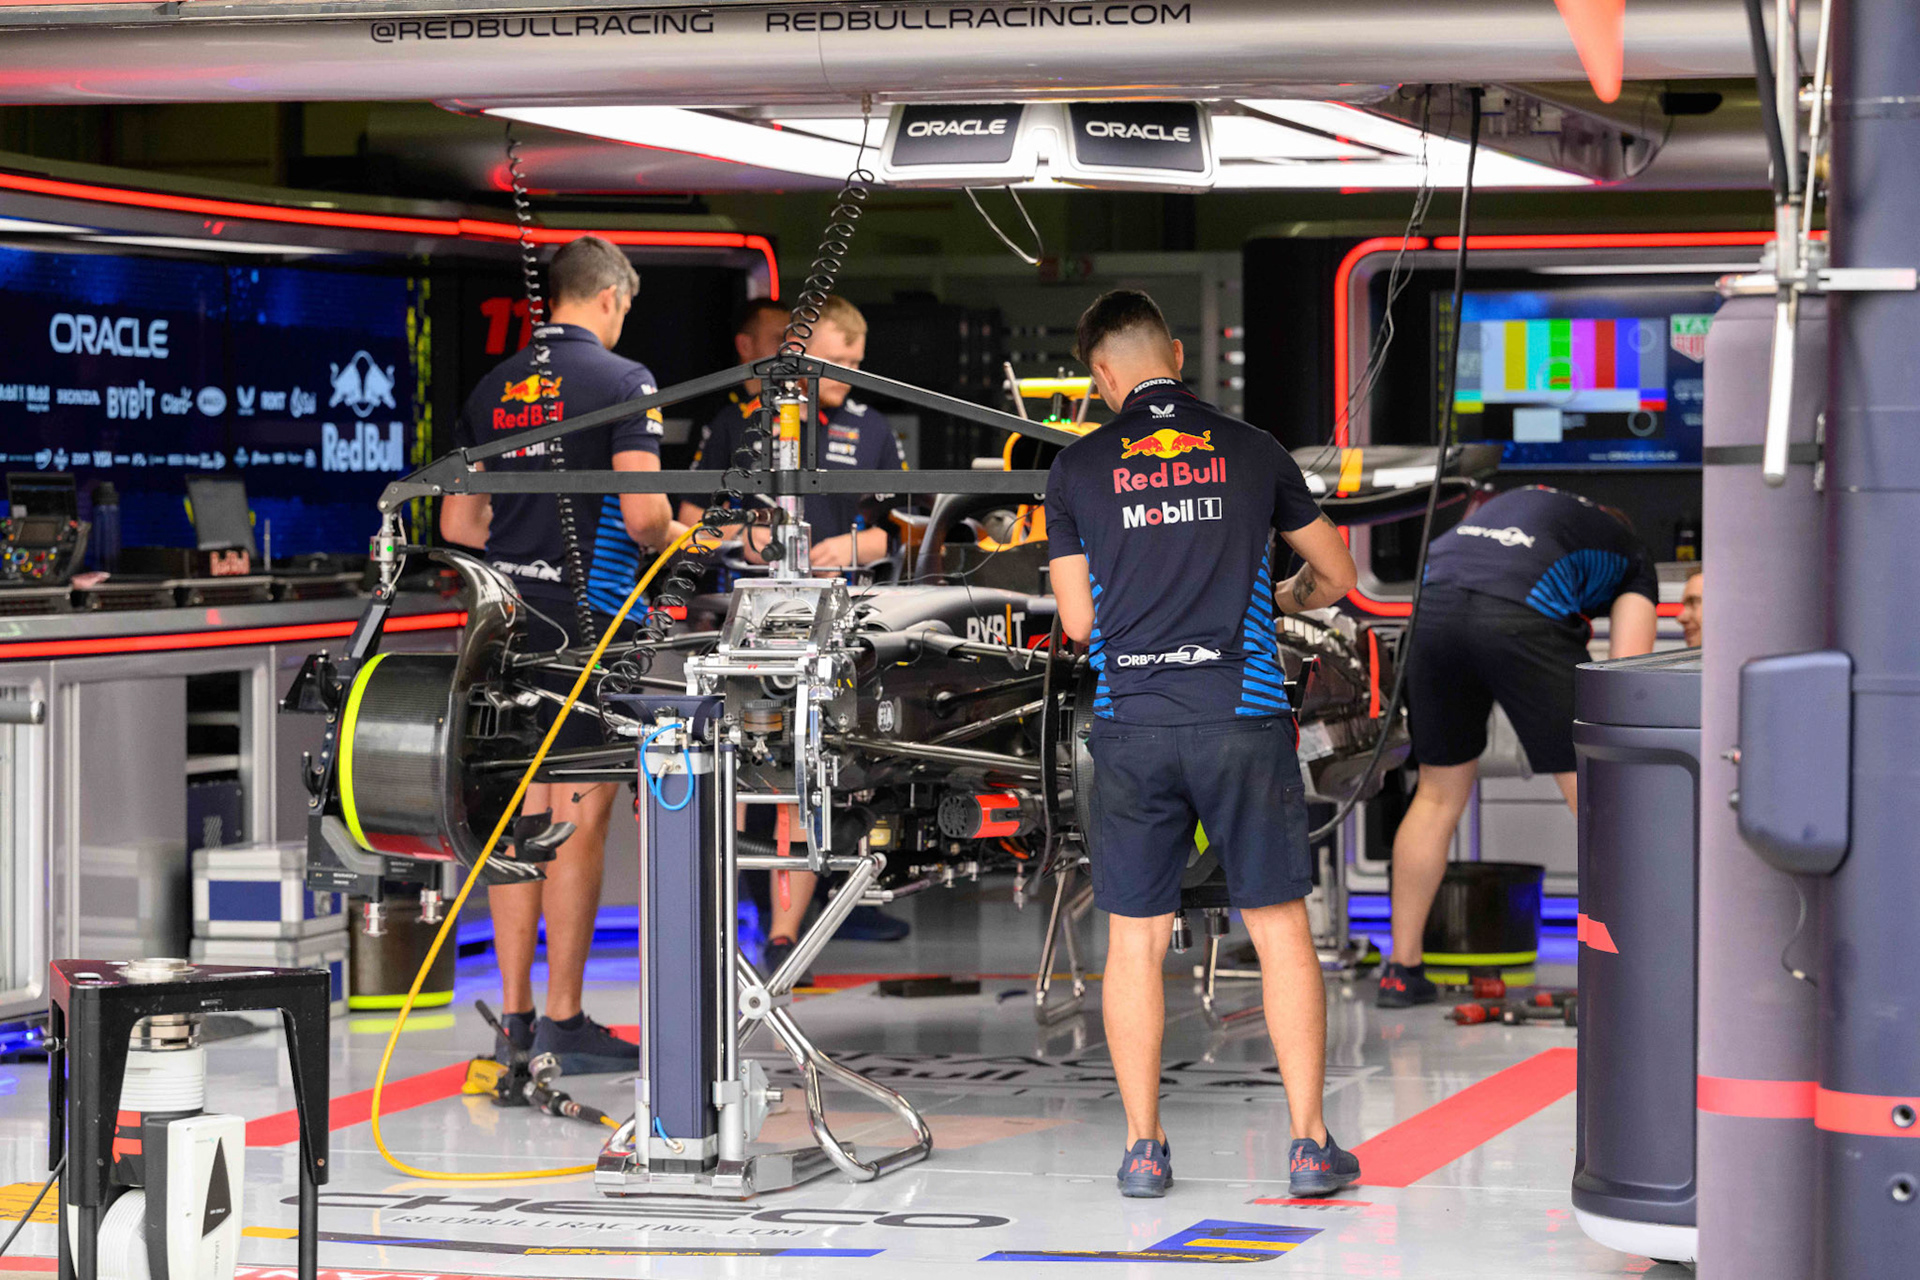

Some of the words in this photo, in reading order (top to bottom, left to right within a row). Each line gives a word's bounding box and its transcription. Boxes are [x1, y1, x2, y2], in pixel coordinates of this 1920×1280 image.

[371, 14, 714, 43] @REDBULLRACING
[766, 4, 1191, 32] REDBULLRACING.COM
[907, 119, 1007, 137] ORACLE
[1086, 121, 1191, 142] ORACLE
[49, 313, 170, 359] ORACLE
[106, 379, 155, 420] BYBIT
[1134, 378, 1176, 394] HONDA
[493, 407, 528, 430] Red
[322, 421, 363, 472] Red
[364, 421, 404, 472] Bull
[1113, 462, 1169, 494] Red
[1172, 457, 1227, 487] Bull
[1122, 499, 1194, 529] Mobil
[280, 1192, 1010, 1229] CHECO
[391, 1214, 806, 1237] REDBULLRACING.COM
